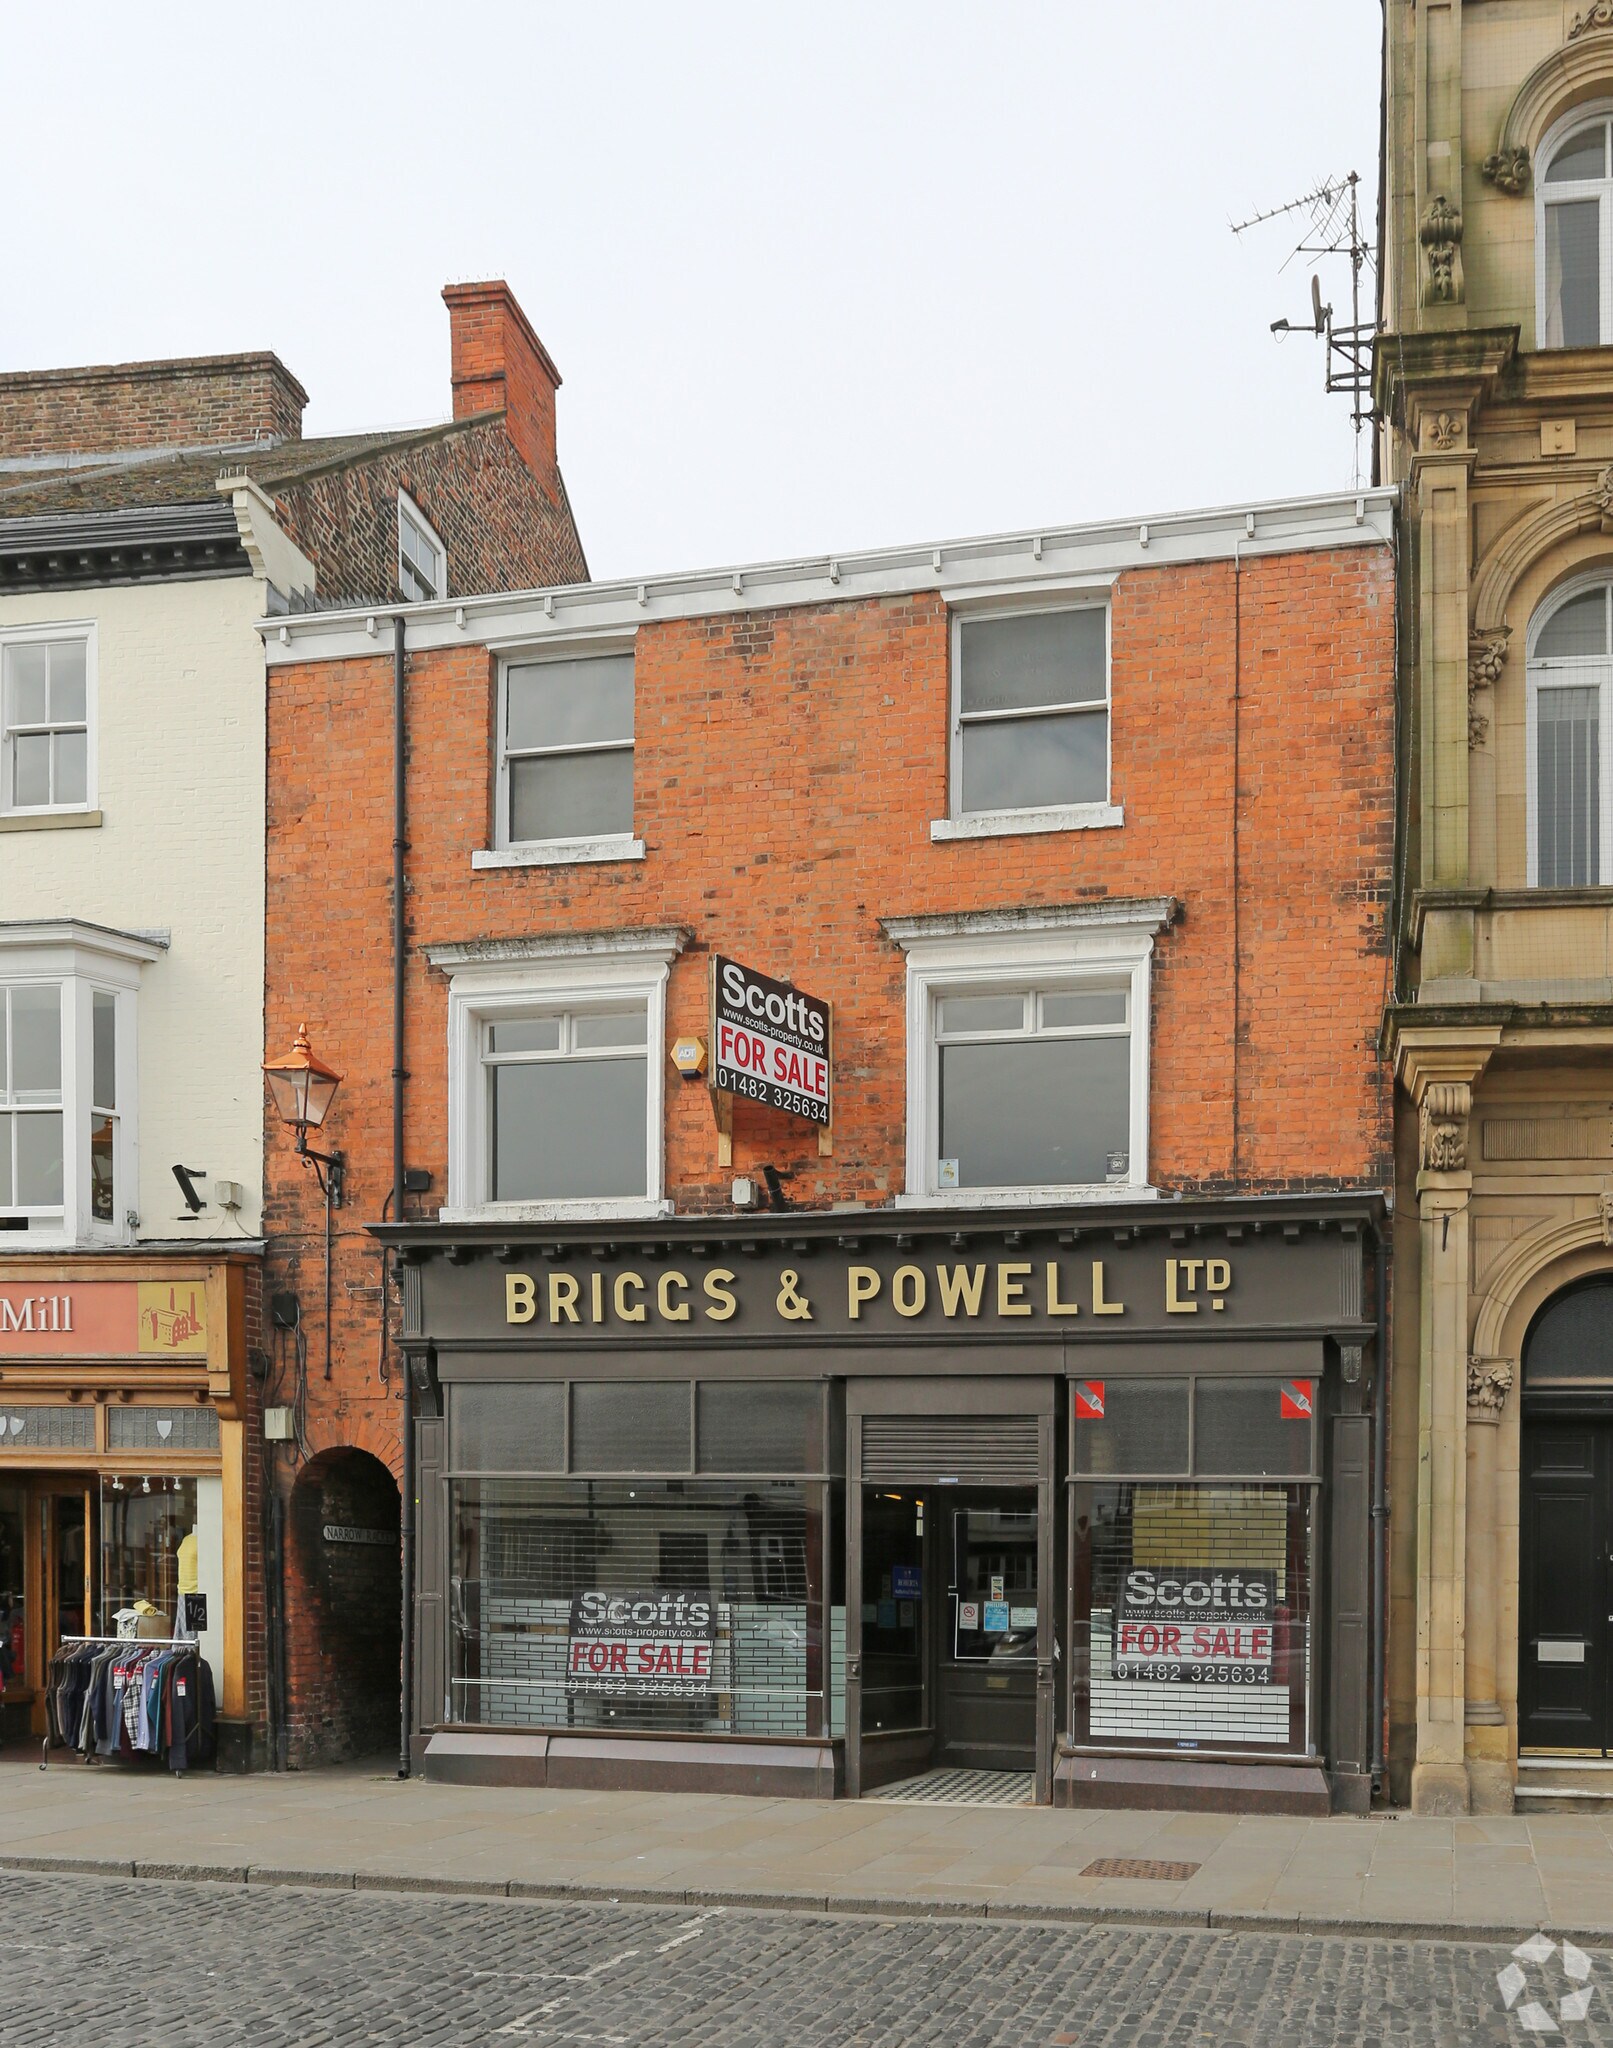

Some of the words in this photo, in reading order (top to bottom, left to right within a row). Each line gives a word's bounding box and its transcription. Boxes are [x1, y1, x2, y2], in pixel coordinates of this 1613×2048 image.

[722, 964, 824, 1041] Scotts
[723, 1007, 824, 1055] www.scotts-property.co.uk
[721, 1025, 767, 1075] FOR
[774, 1047, 826, 1097] SALE
[718, 1068, 767, 1101] 01482
[774, 1088, 828, 1123] 325634
[505, 1268, 737, 1324] BRIGGS
[775, 1268, 813, 1320] &
[847, 1261, 1124, 1319] POWELL
[0, 1295, 74, 1332] Mill
[326, 1526, 361, 1541] NARROW
[1125, 1570, 1268, 1607] Scotts
[187, 1601, 206, 1621] 1/2
[578, 1592, 710, 1627] Scotts
[572, 1642, 629, 1672] FOR
[637, 1644, 709, 1675] SALE
[1121, 1625, 1182, 1656] FOR
[1191, 1627, 1268, 1660] SALE
[1117, 1663, 1181, 1681] 01482
[1191, 1665, 1270, 1684] 325634
